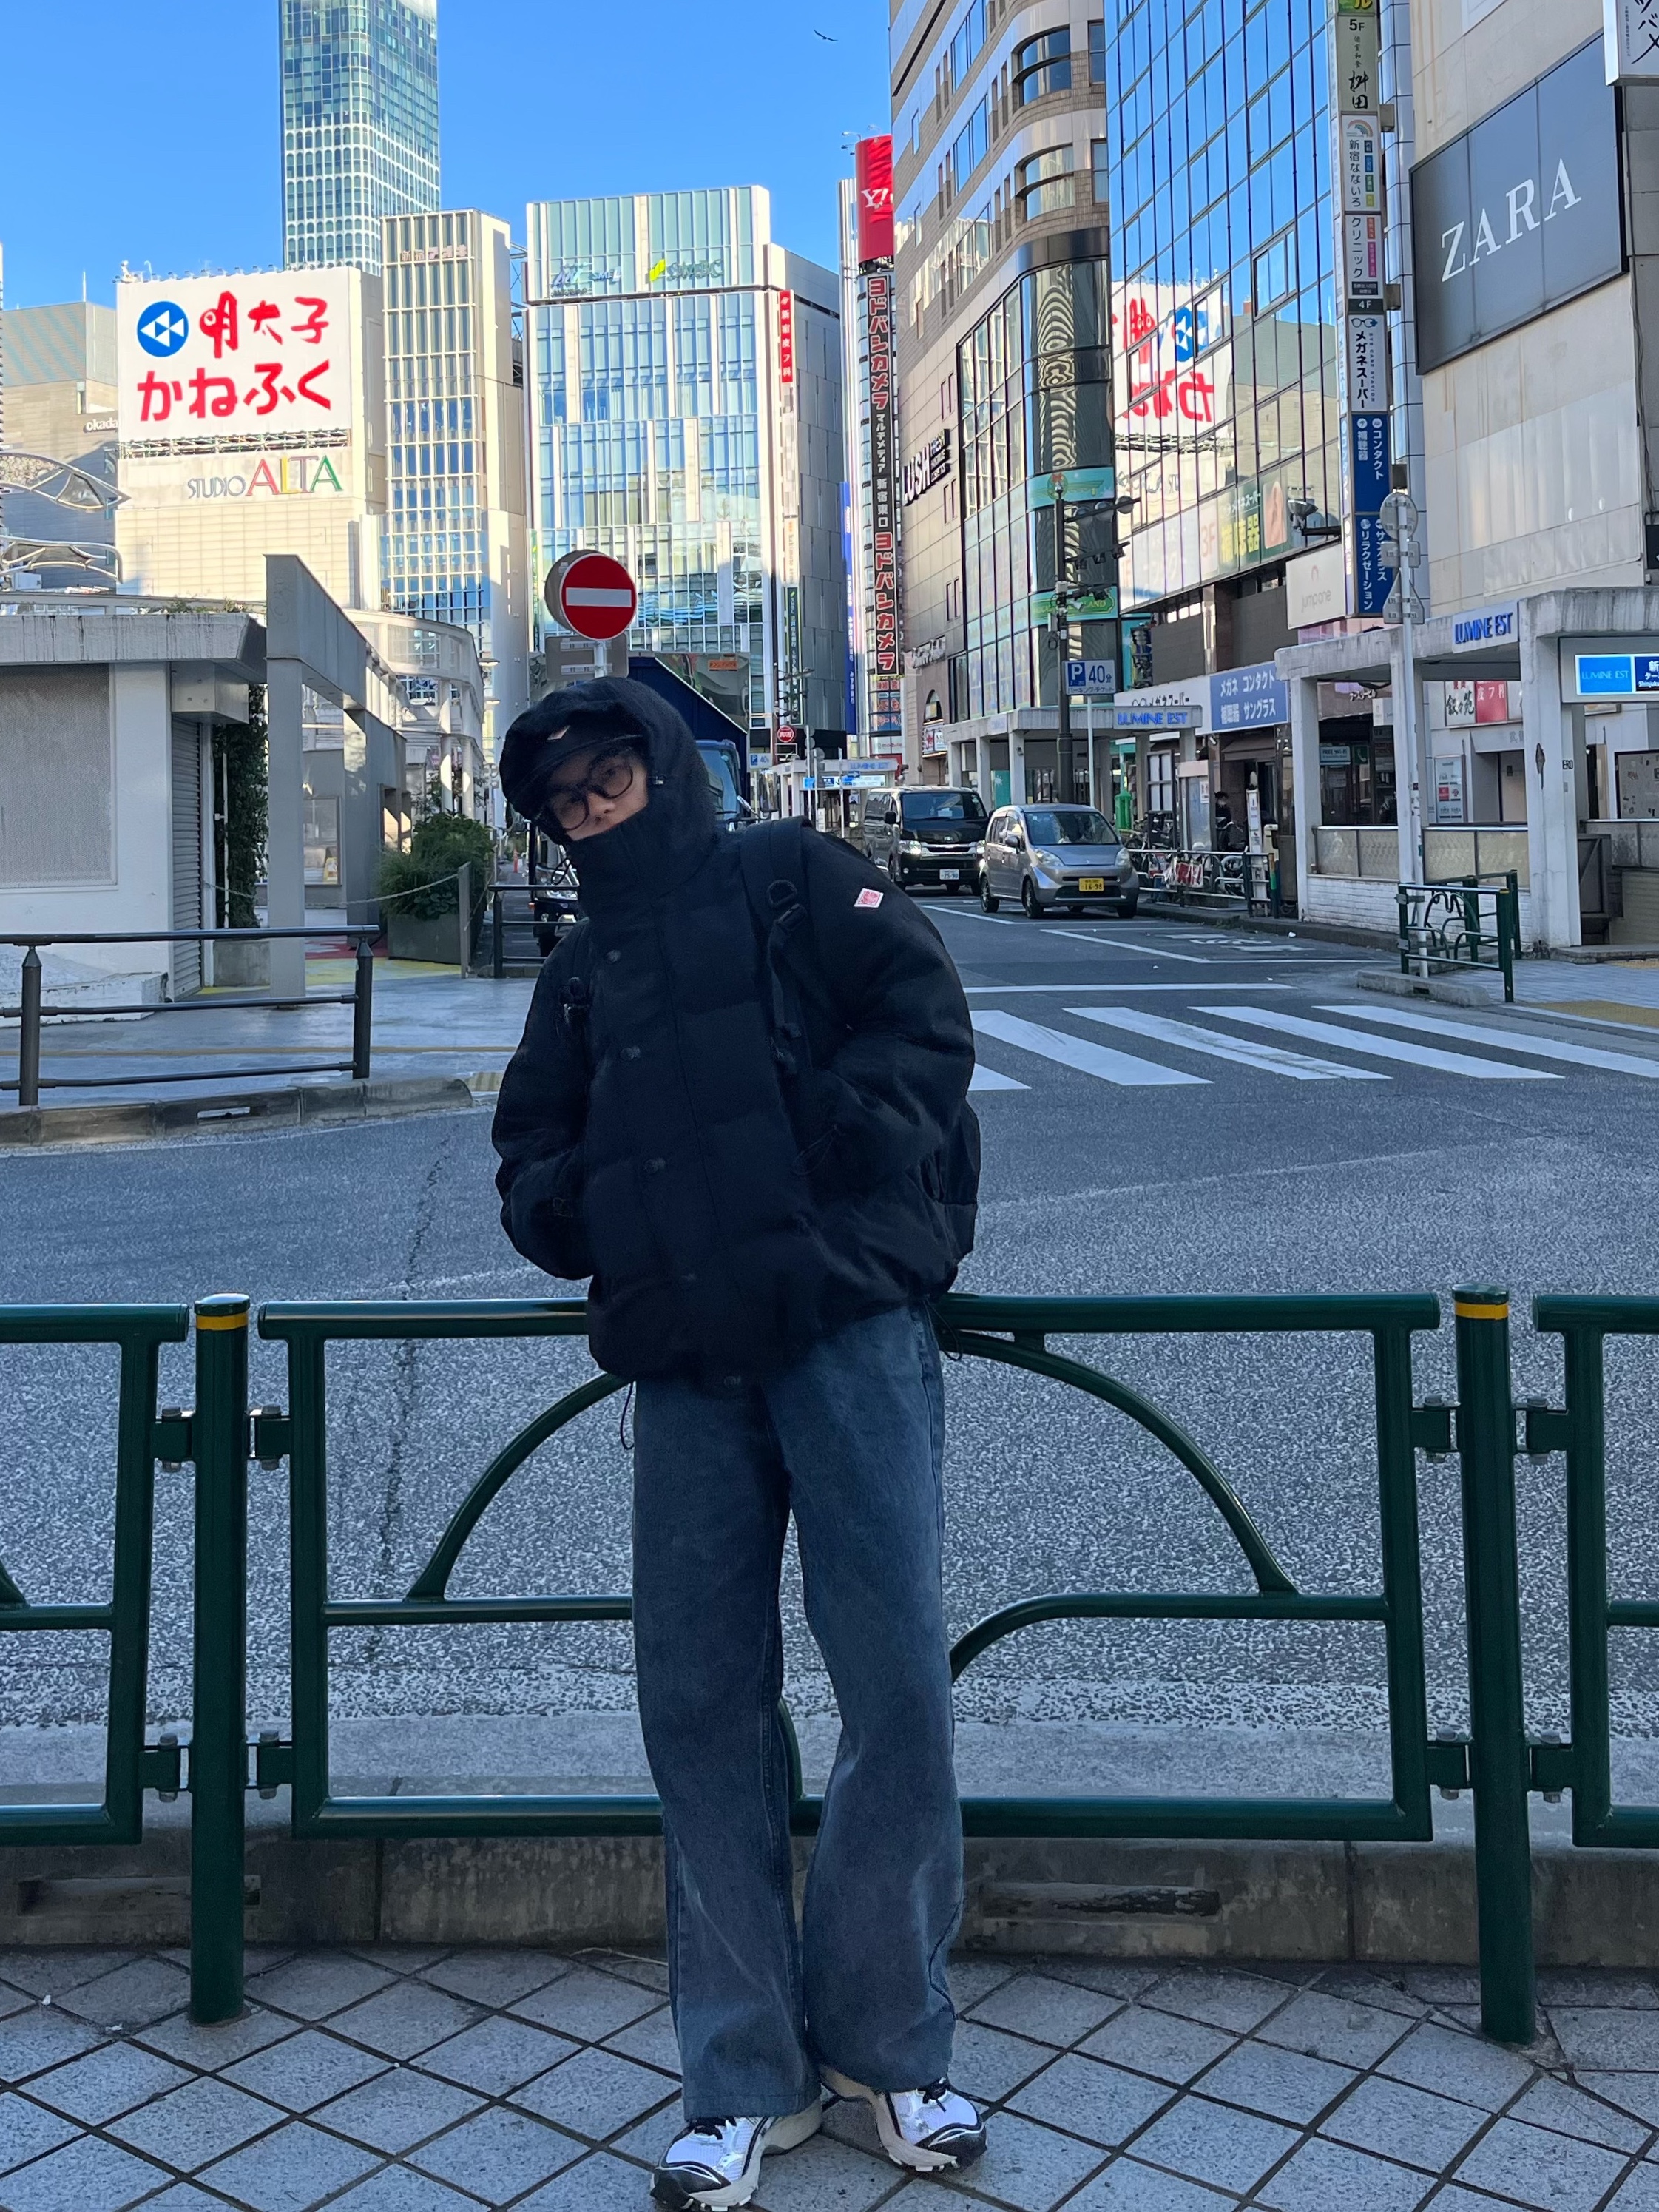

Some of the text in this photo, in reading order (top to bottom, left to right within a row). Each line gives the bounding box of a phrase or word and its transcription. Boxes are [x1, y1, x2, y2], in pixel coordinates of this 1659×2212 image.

[1349, 19, 1365, 31] 5F
[1349, 140, 1360, 207] 新宿なないろ
[1441, 158, 1582, 283] ZARA
[666, 259, 724, 281] SMBC
[1352, 217, 1362, 278] クリニック
[199, 291, 330, 359] 明太子
[1359, 300, 1371, 309] 4F
[869, 277, 889, 409] ヨドバシカメラ
[138, 359, 331, 421] かねふく
[1356, 331, 1368, 408] メガネスーパー
[876, 414, 886, 473] マルチメディア
[1373, 430, 1384, 480] コンタクト
[187, 455, 344, 499] STUDIO ALTA
[876, 479, 888, 527] 新宿東口
[1361, 530, 1373, 610] リラクゼーション
[875, 531, 895, 670] ヨドバシカメラ
[1455, 612, 1513, 644] LUMINE EST
[1089, 665, 1112, 684] 40分
[1220, 669, 1275, 697] メガネ コンタクト
[1581, 670, 1629, 680] LUMINE EST
[1118, 711, 1188, 725] LUMINE EST
[1243, 698, 1276, 721] サングラス
